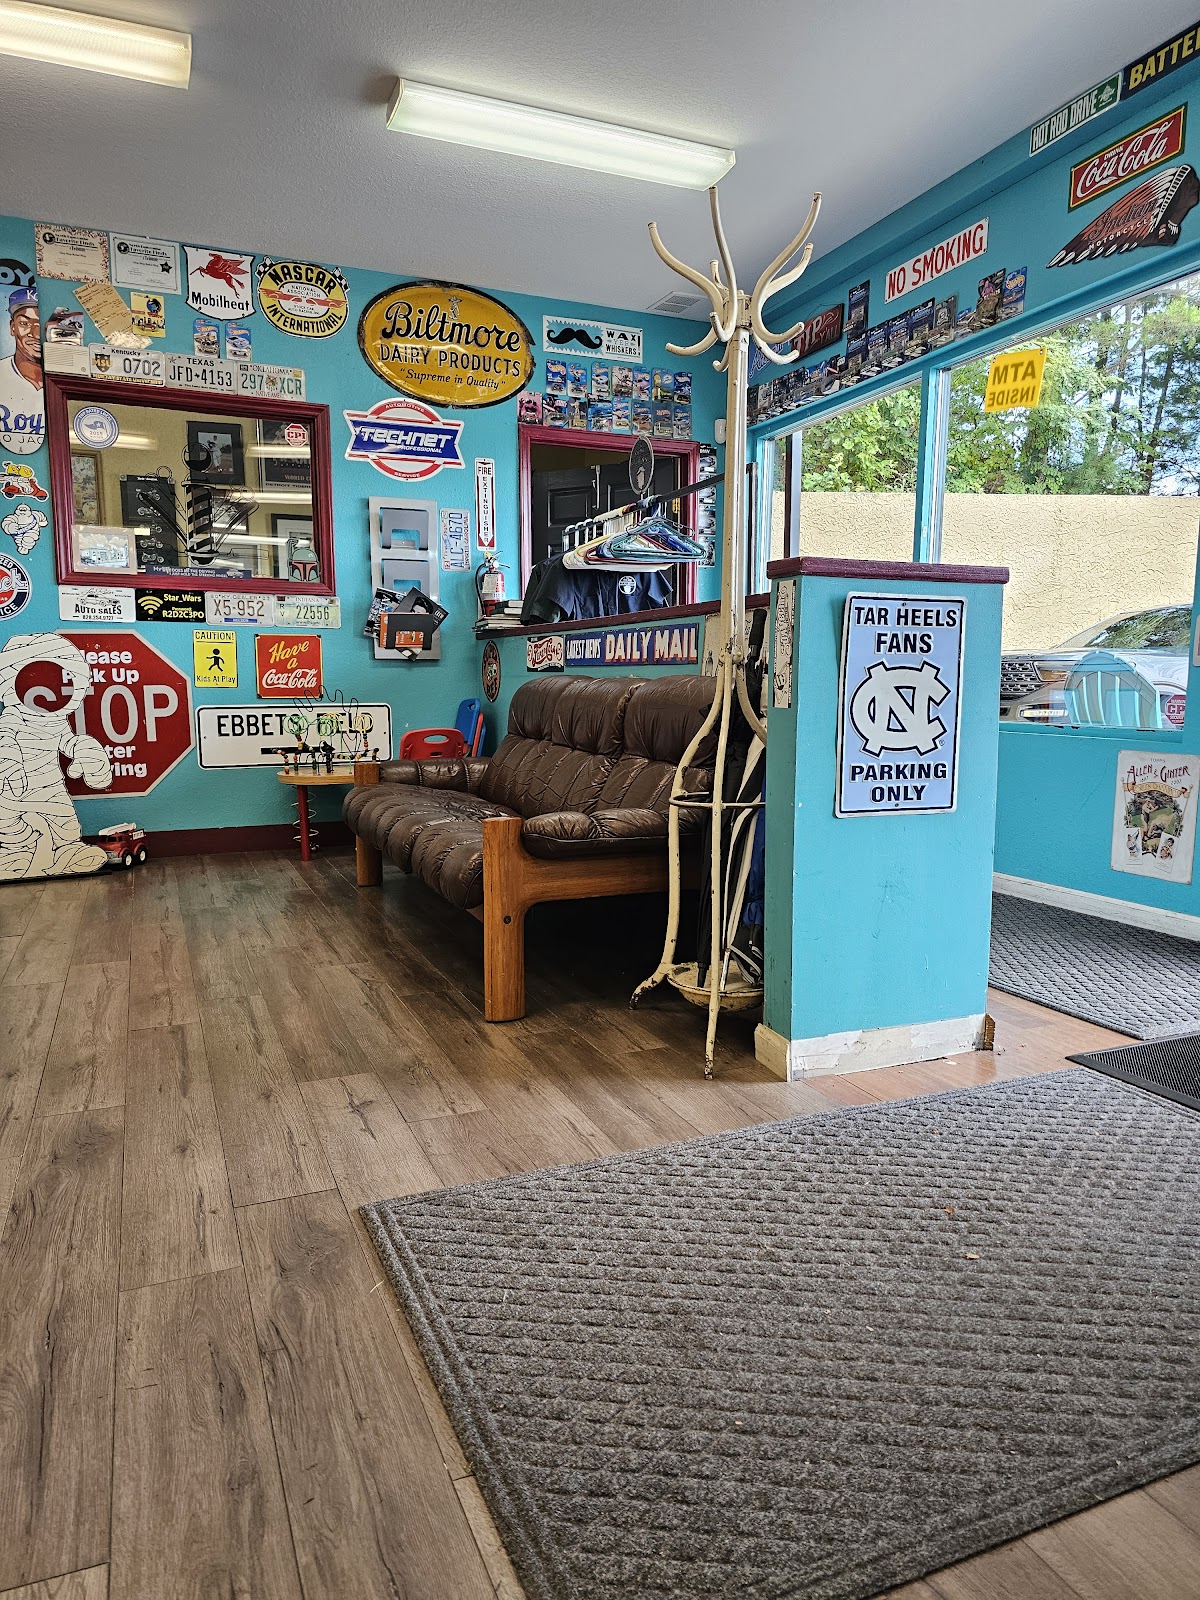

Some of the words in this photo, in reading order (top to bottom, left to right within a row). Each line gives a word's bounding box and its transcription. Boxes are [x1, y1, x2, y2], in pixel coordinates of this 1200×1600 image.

[1033, 124, 1050, 150] HOT
[1050, 112, 1067, 134] ROD
[1070, 90, 1097, 124] DRIVE
[1076, 120, 1174, 198] Coca-Cola
[887, 266, 906, 299] NO
[911, 223, 984, 287] SMOKING
[268, 264, 337, 295] NASCAR
[191, 291, 250, 311] Mobilheat
[266, 303, 343, 334] INTERNATIONAL
[381, 300, 521, 352] Biltmore
[111, 349, 141, 357] Kentucky
[187, 357, 215, 367] TEXAS
[380, 344, 430, 365] DAIRY
[439, 351, 521, 377] PRODUCTS
[92, 358, 113, 369] MSU
[123, 358, 161, 377] 0702
[252, 364, 290, 375] OKLAHOMA
[241, 373, 264, 390] 297
[279, 377, 302, 395] XCR
[454, 374, 463, 384] in
[385, 402, 425, 412] AUTOMOTIVE
[287, 432, 306, 440] CPI
[396, 445, 443, 453] PROFESSIONAL
[477, 466, 492, 475] FIRE
[449, 512, 464, 568] ALC-4670
[163, 593, 202, 602] Star_Wars
[75, 604, 96, 613] AUTO
[98, 604, 122, 615] SALES
[162, 609, 205, 618] R2D2C3PO
[213, 599, 265, 617] X5-952
[295, 605, 330, 620] 22556
[854, 606, 889, 626] TAR
[896, 608, 957, 627] HEELS
[195, 631, 235, 642] CAUTION!
[567, 639, 585, 660] LATEST
[585, 638, 601, 659] NEWS
[604, 631, 651, 663] DAILY
[654, 628, 698, 662] MAIL
[874, 632, 933, 654] FANS
[80, 650, 132, 664] lease
[269, 641, 309, 663] Have
[287, 657, 298, 669] a
[62, 667, 107, 684] Pck
[112, 668, 140, 684] Up
[221, 676, 236, 685] Play
[262, 668, 318, 689] Coca-Cola
[24, 685, 179, 743] STOP
[105, 745, 137, 757] ter
[850, 763, 947, 782] PARKING
[1127, 764, 1153, 786] ALLEN
[1160, 765, 1191, 783] GINTER
[870, 785, 926, 803] ONLY
